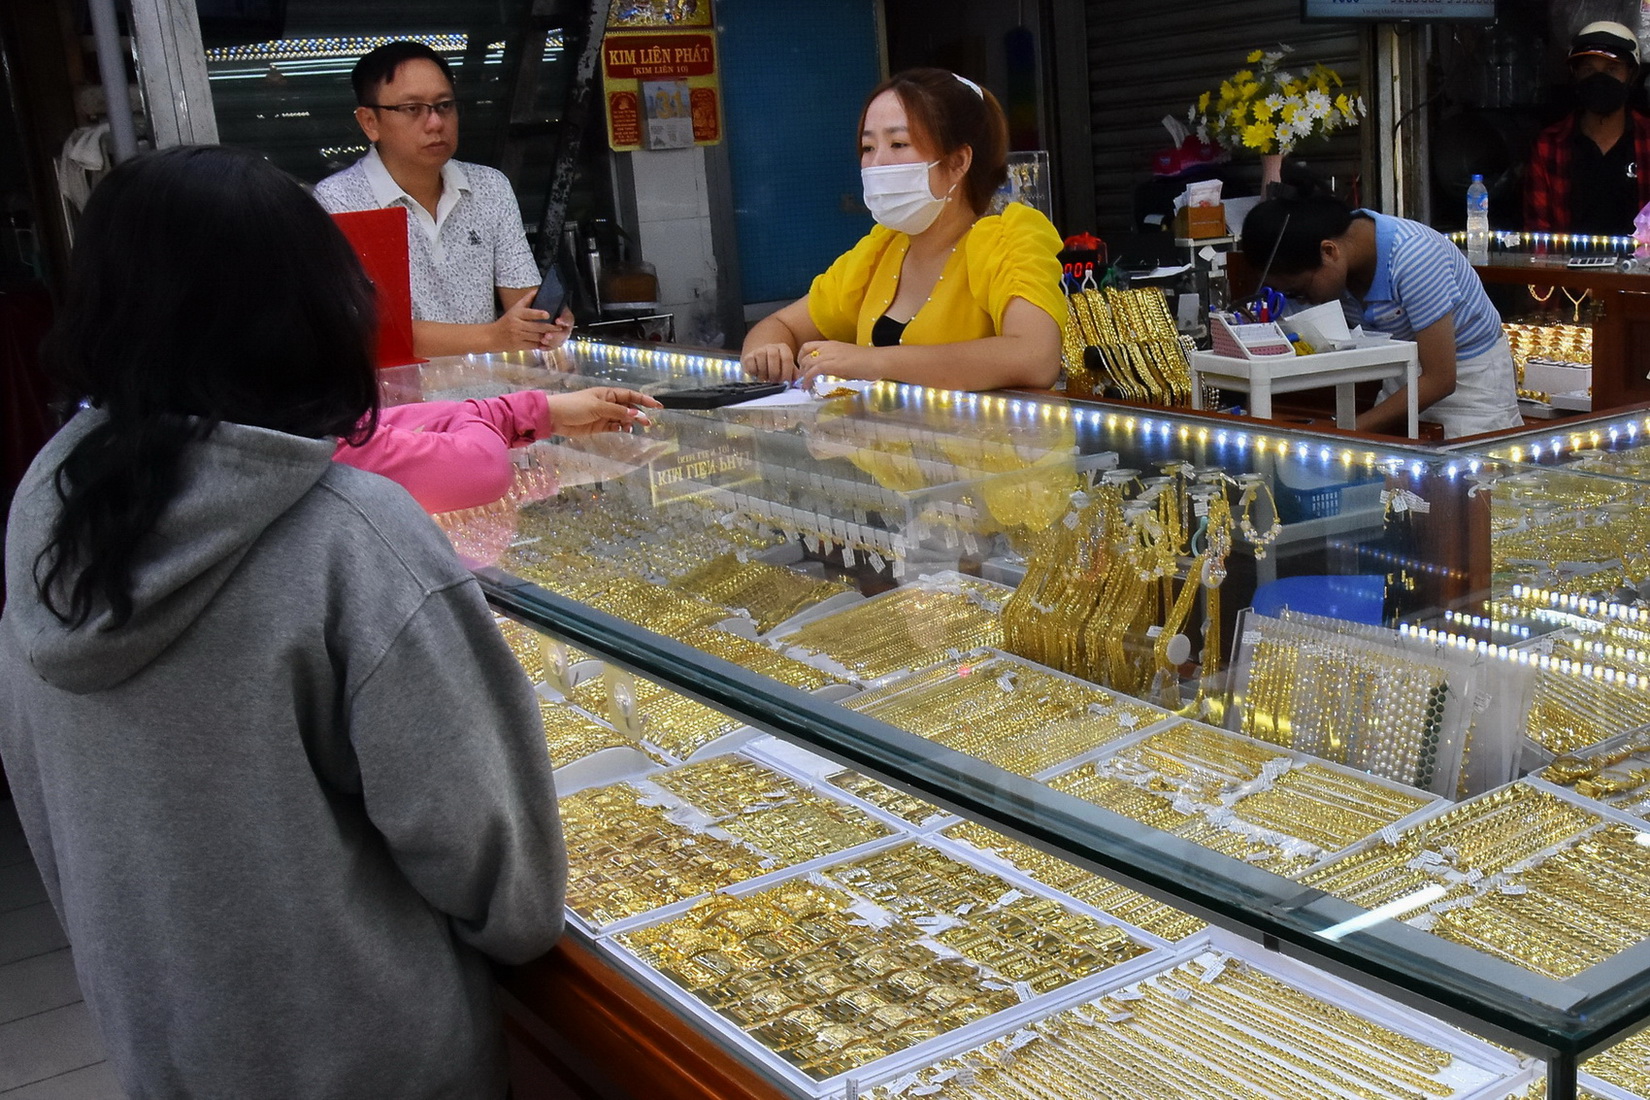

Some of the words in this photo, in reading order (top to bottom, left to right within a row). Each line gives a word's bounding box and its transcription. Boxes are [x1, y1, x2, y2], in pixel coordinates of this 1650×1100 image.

[609, 50, 636, 65] KIM
[640, 45, 671, 64] LIÊN
[675, 44, 709, 63] PHÁT
[633, 66, 652, 75] (KIM
[654, 65, 674, 73] LIÊN
[677, 65, 688, 73] 10)
[656, 91, 683, 119] 31
